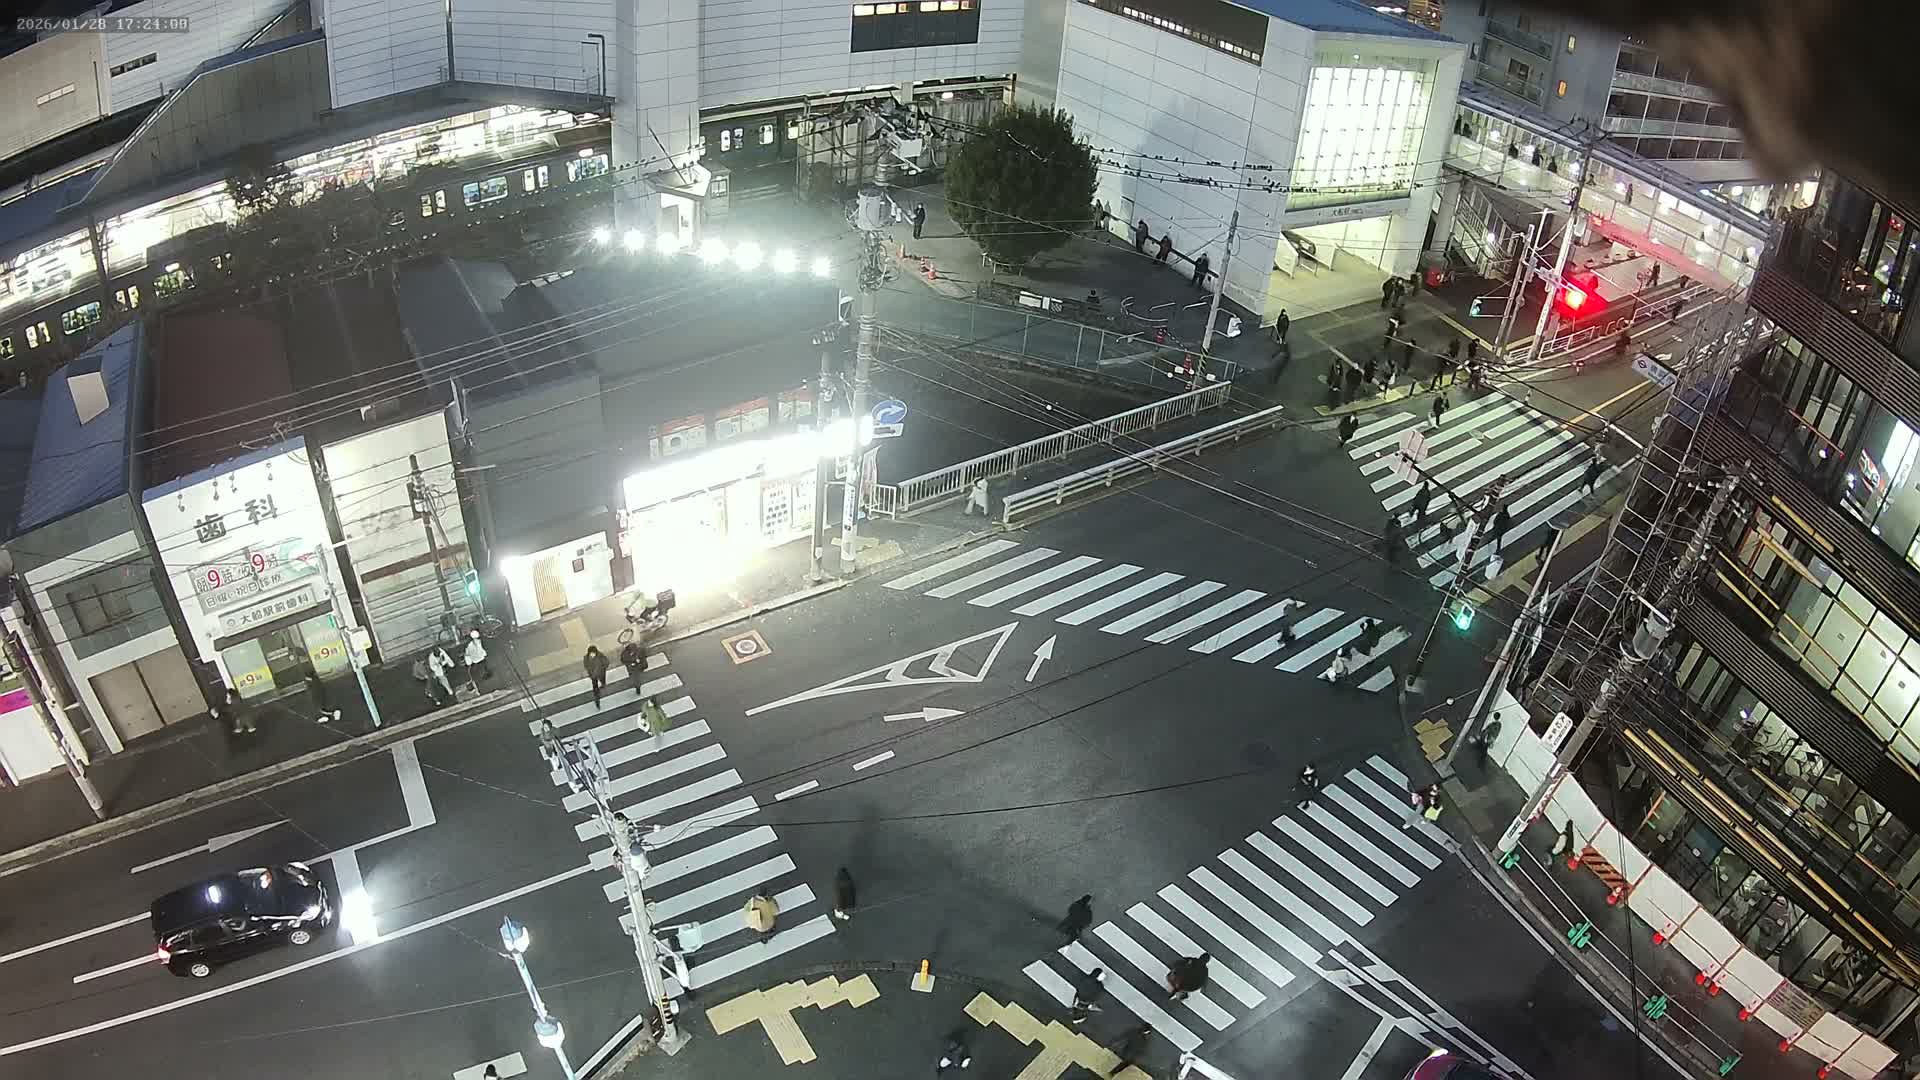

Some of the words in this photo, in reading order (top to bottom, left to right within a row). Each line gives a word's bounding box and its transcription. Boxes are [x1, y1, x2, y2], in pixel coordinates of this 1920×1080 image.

[193, 494, 277, 543] 歯科
[240, 592, 309, 624] 大船駅前歯科
